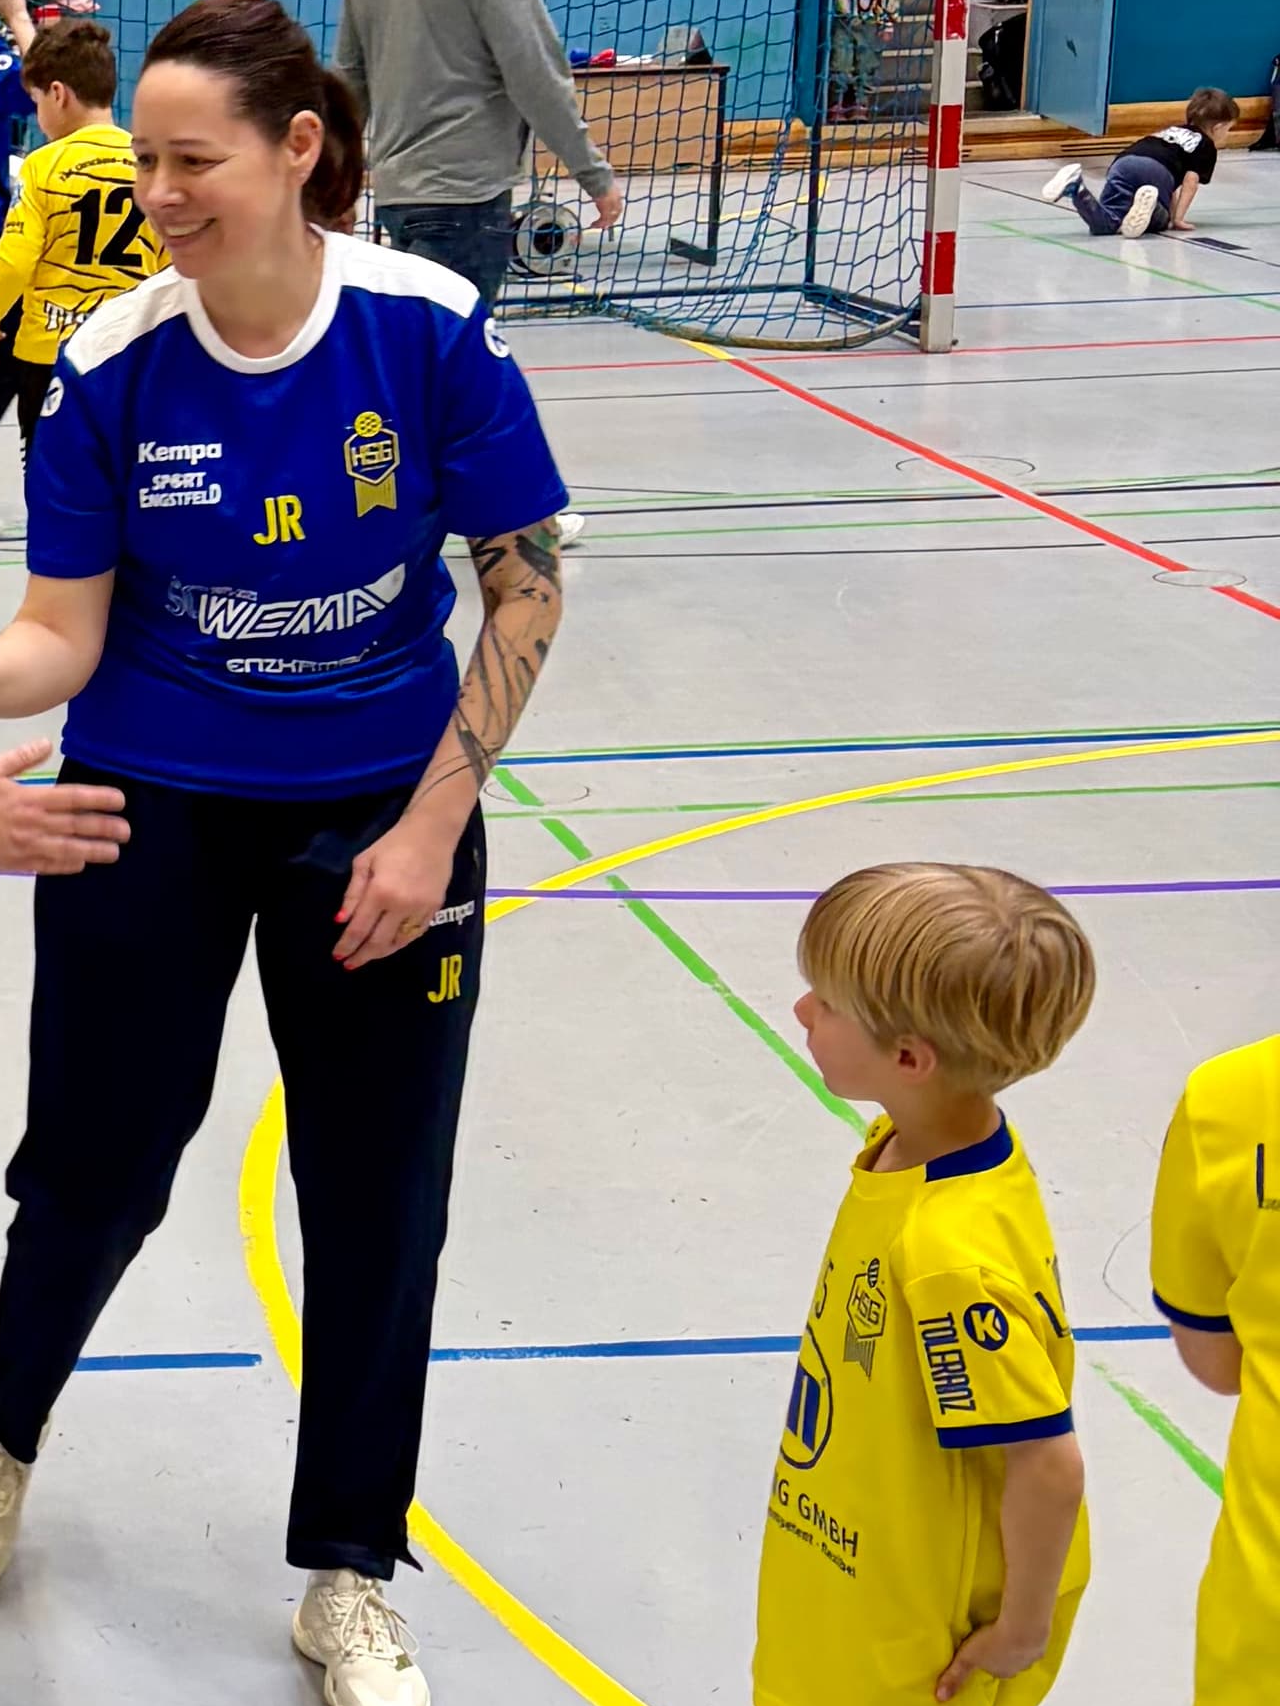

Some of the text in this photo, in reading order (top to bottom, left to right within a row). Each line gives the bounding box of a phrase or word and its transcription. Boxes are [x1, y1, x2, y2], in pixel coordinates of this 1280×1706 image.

[72, 185, 147, 269] 12
[138, 441, 223, 466] Kempa
[151, 471, 207, 490] SPORT
[253, 494, 307, 546] JR
[197, 569, 403, 641] WEMA
[429, 899, 476, 927] empa
[426, 953, 463, 1004] JR
[851, 1285, 882, 1327] HSG
[797, 1491, 859, 1559] GMBH
